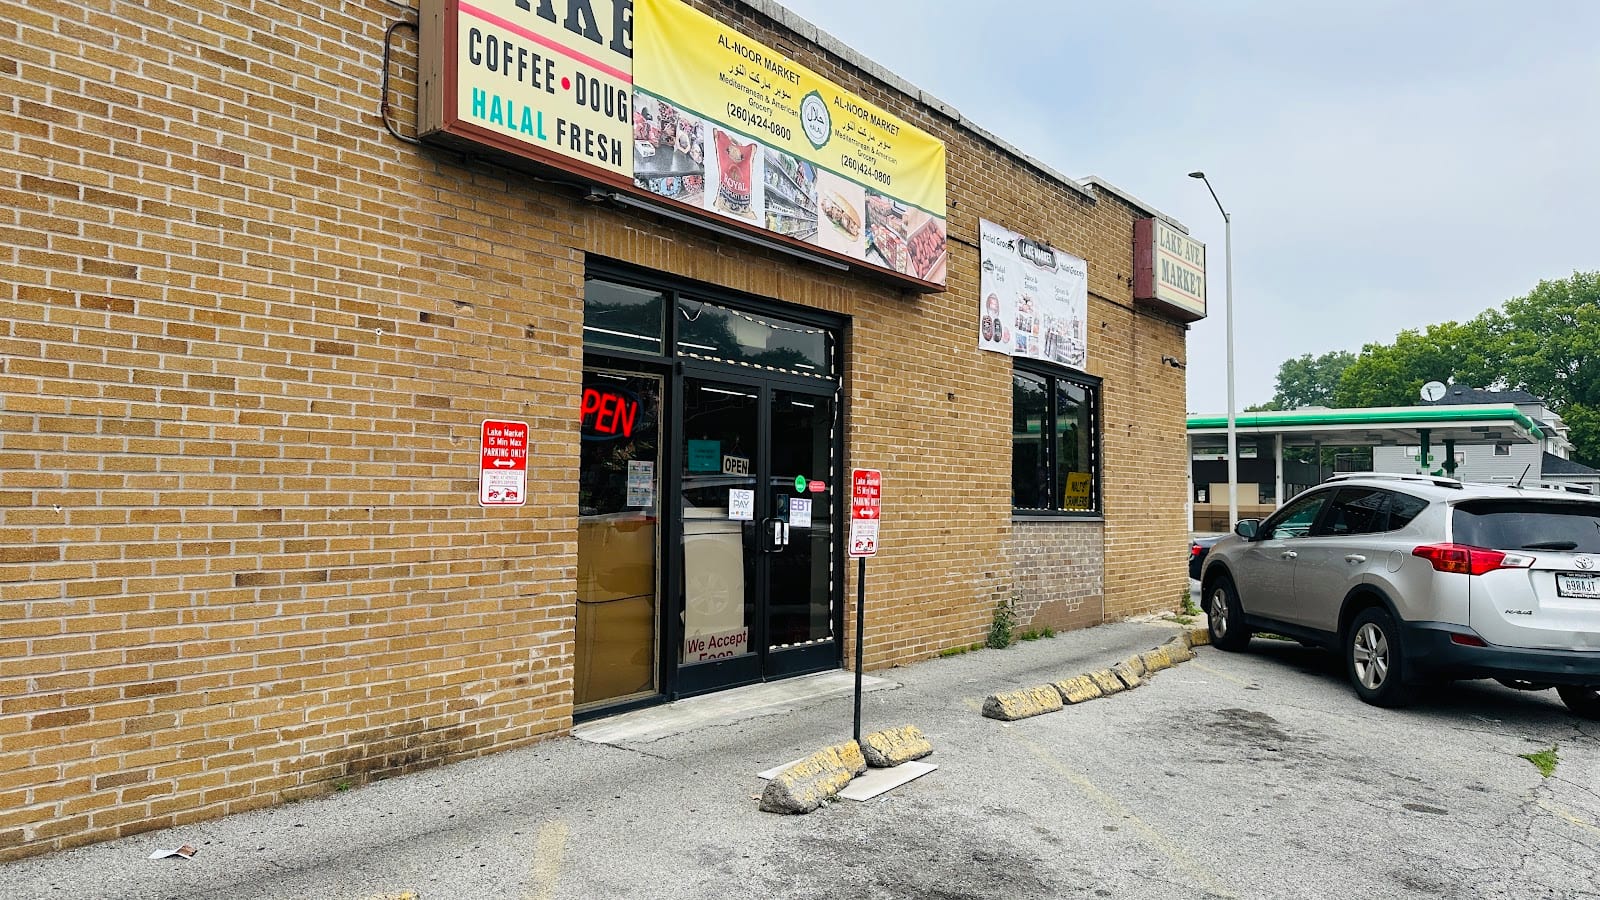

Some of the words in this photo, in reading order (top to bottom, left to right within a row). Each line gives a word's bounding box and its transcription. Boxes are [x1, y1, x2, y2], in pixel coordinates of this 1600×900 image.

[718, 34, 762, 66] AL-NOOR
[765, 58, 800, 85] MARKET
[469, 28, 555, 94] COFFEE
[576, 71, 633, 125] DOUG
[719, 72, 764, 102] Mediterranean
[764, 95, 770, 104] &
[771, 98, 799, 117] American
[748, 97, 773, 116] Grocery
[834, 96, 869, 121] AL-NOOR
[870, 114, 900, 136] MARKET
[472, 87, 547, 140] HALAL
[557, 117, 622, 166] FRESH
[726, 102, 791, 140] (260)424-0800
[857, 150, 877, 165] Grocery
[841, 154, 891, 186] (260)424-0800
[1159, 227, 1182, 256] LAKE
[1185, 241, 1203, 267] AVE.
[1161, 258, 1202, 298] MARKET
[580, 388, 637, 438] PEN
[487, 427, 502, 437] Lake
[503, 428, 524, 438] Market
[488, 437, 495, 446] 15
[496, 437, 508, 446] Min
[510, 438, 522, 447] Max
[484, 447, 508, 458] PARKING
[510, 448, 525, 458] ONLY
[725, 457, 748, 474] OPEN
[856, 477, 866, 485] Lake
[857, 486, 862, 494] 15
[862, 486, 870, 495] Min
[733, 491, 750, 500] NRS
[733, 500, 750, 508] PAY
[791, 499, 811, 511] EBT
[688, 638, 705, 653] We
[708, 630, 747, 650] Accept
